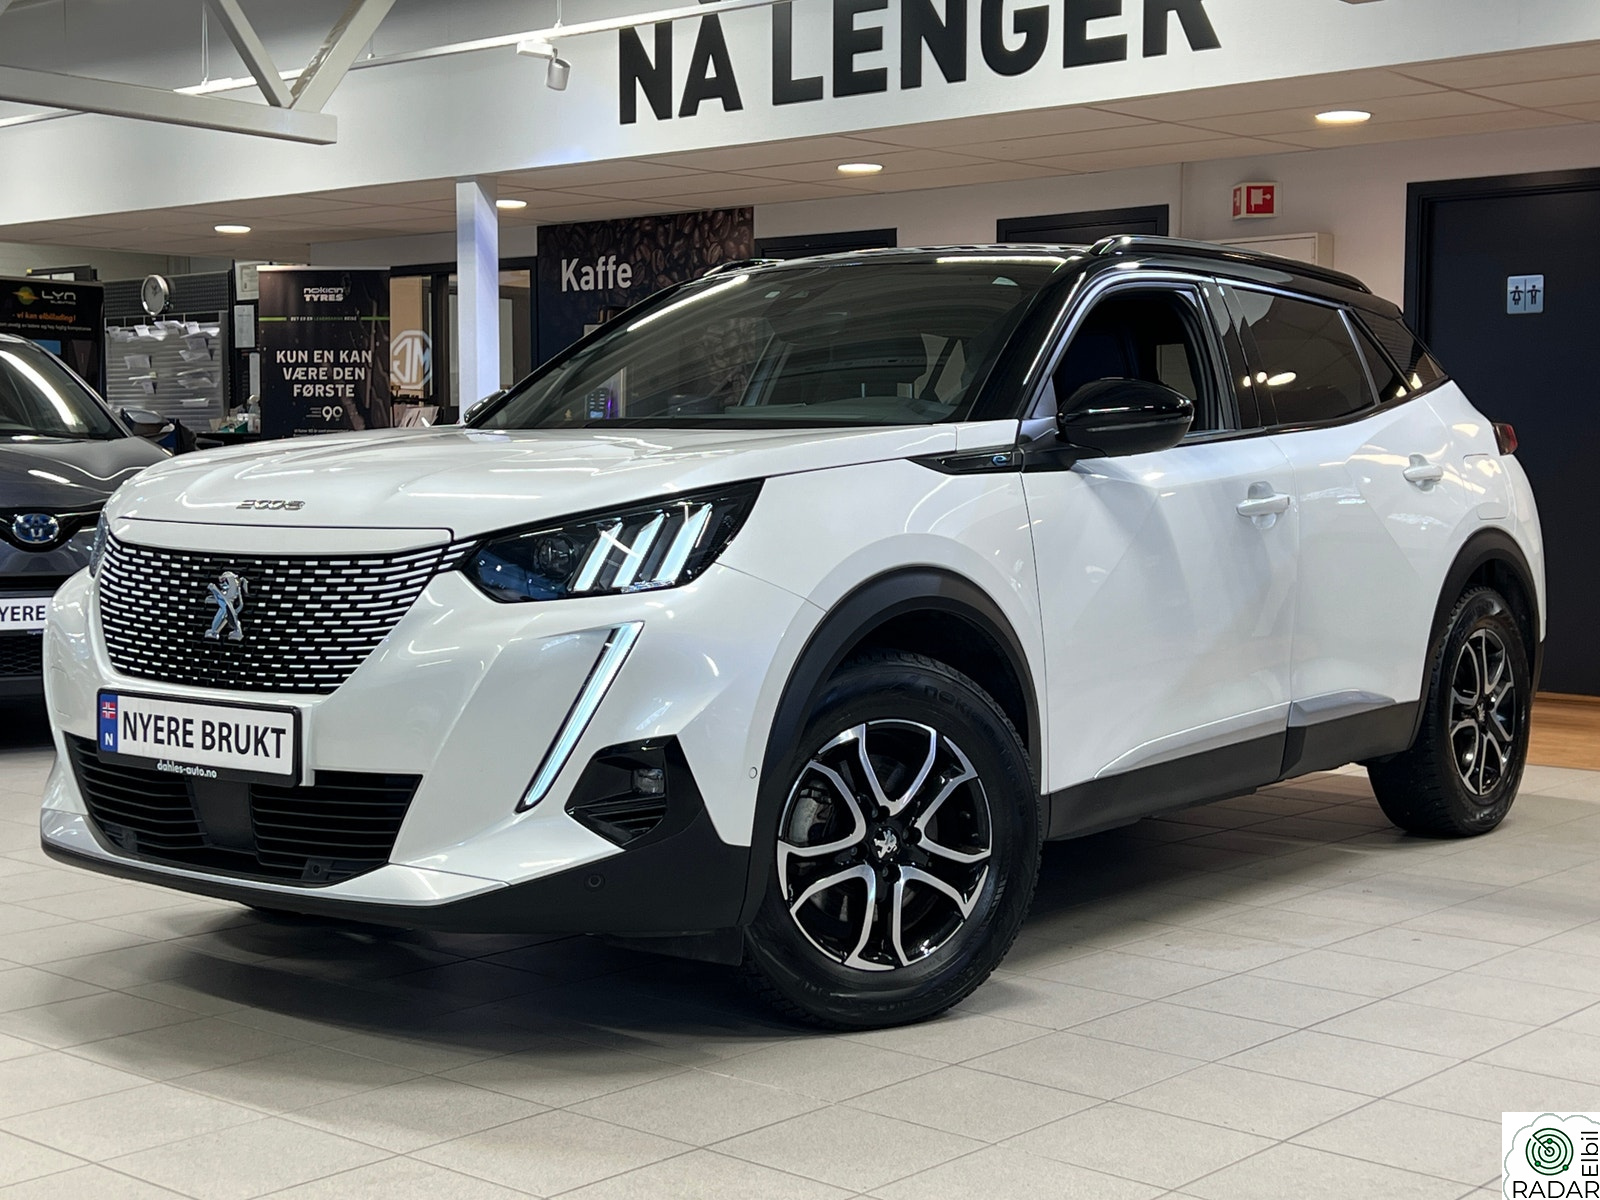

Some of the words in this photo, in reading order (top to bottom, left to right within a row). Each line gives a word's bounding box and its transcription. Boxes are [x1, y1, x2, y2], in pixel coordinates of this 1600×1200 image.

[561, 255, 633, 292] Kaffe
[304, 294, 344, 302] TYRES
[276, 350, 308, 363] KUN
[313, 350, 334, 363] EN
[339, 350, 372, 363] KAN
[283, 367, 328, 380] VÆRE
[333, 367, 365, 380] DEN
[293, 384, 355, 397] FØRSTE
[322, 405, 343, 421] 90
[104, 733, 114, 746] N
[122, 710, 194, 749] NYERE
[201, 720, 287, 759] BRUKT
[157, 759, 217, 779] dahles-auto.no
